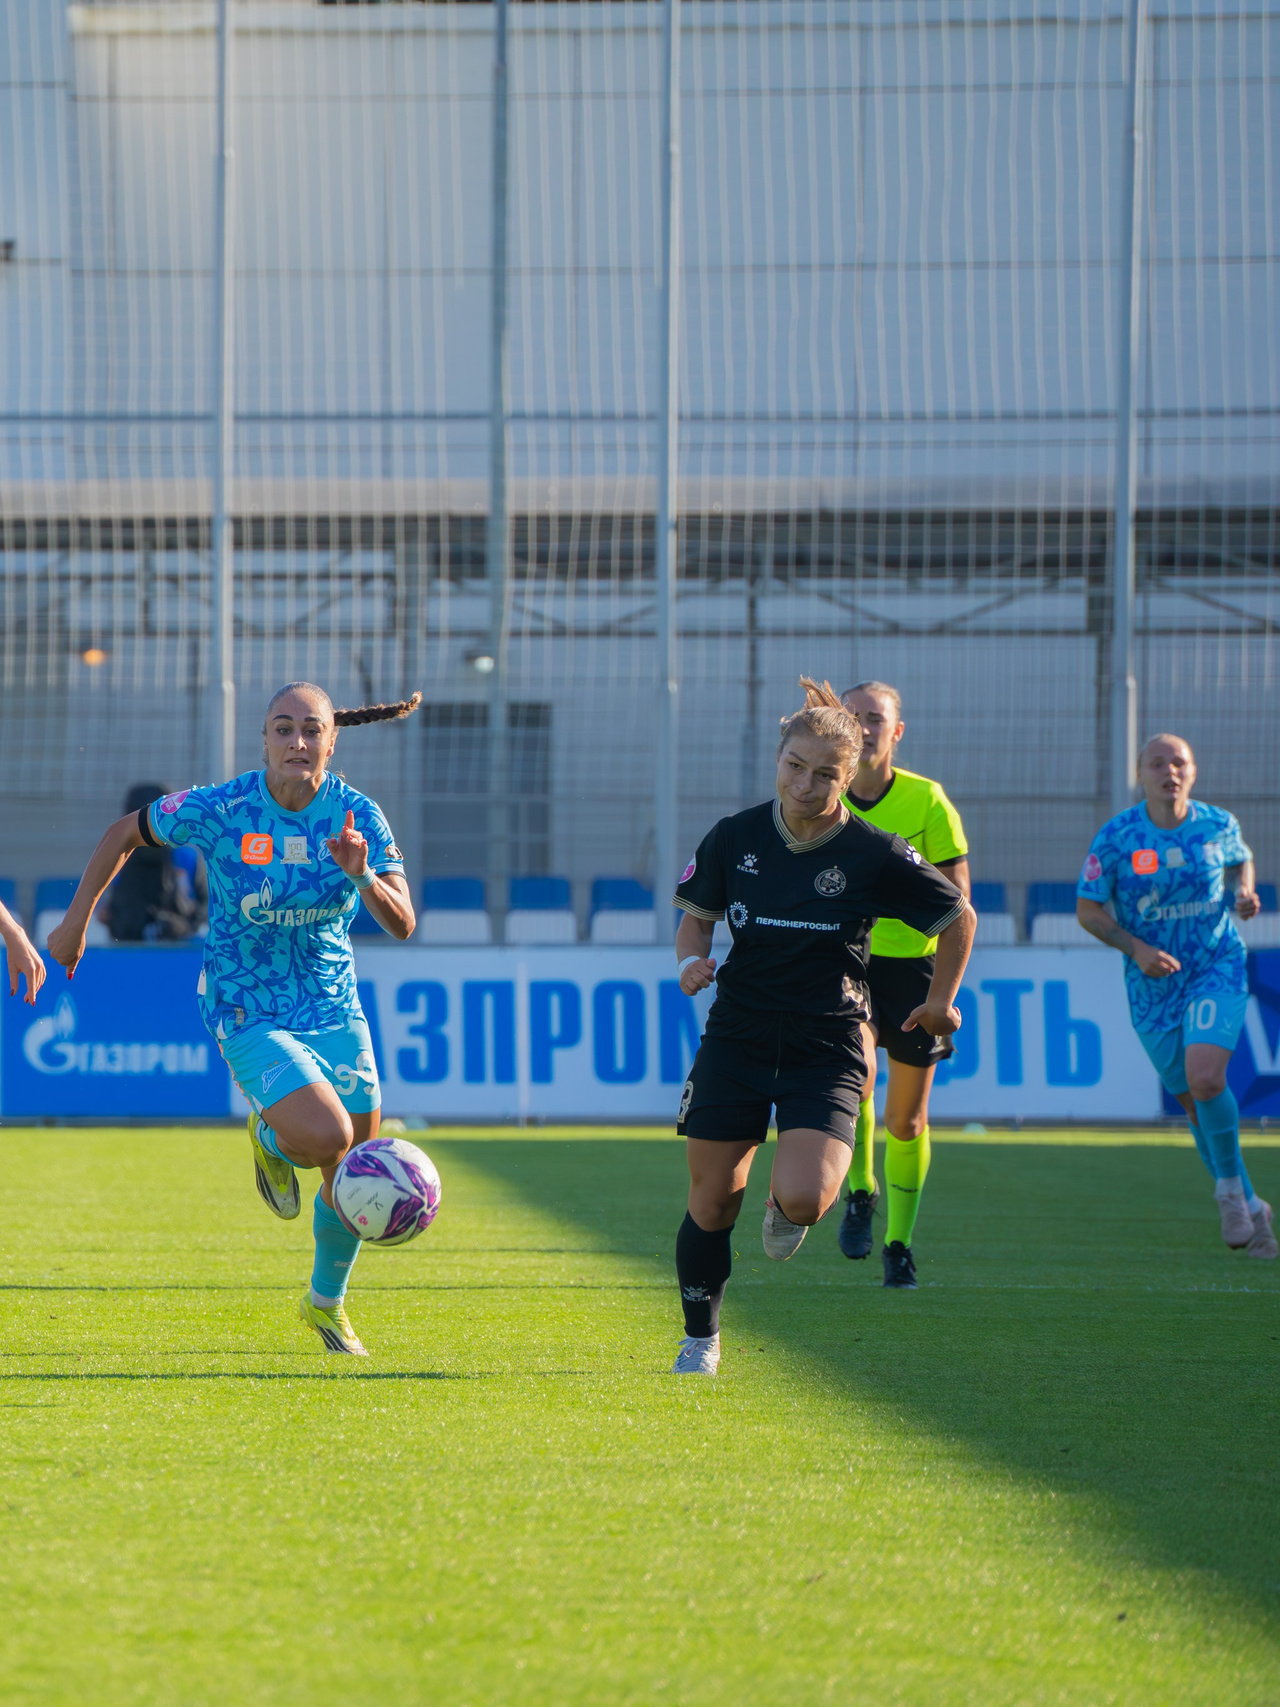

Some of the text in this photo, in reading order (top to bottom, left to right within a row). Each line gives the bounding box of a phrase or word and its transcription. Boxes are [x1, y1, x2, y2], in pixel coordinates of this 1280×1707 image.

[736, 864, 760, 876] KELME
[755, 916, 842, 931] ПЕРМЭНЕРГОСБЫТ
[1188, 998, 1217, 1032] 10
[75, 1042, 209, 1074] ГАЗПРОМ
[333, 1050, 377, 1096] 99
